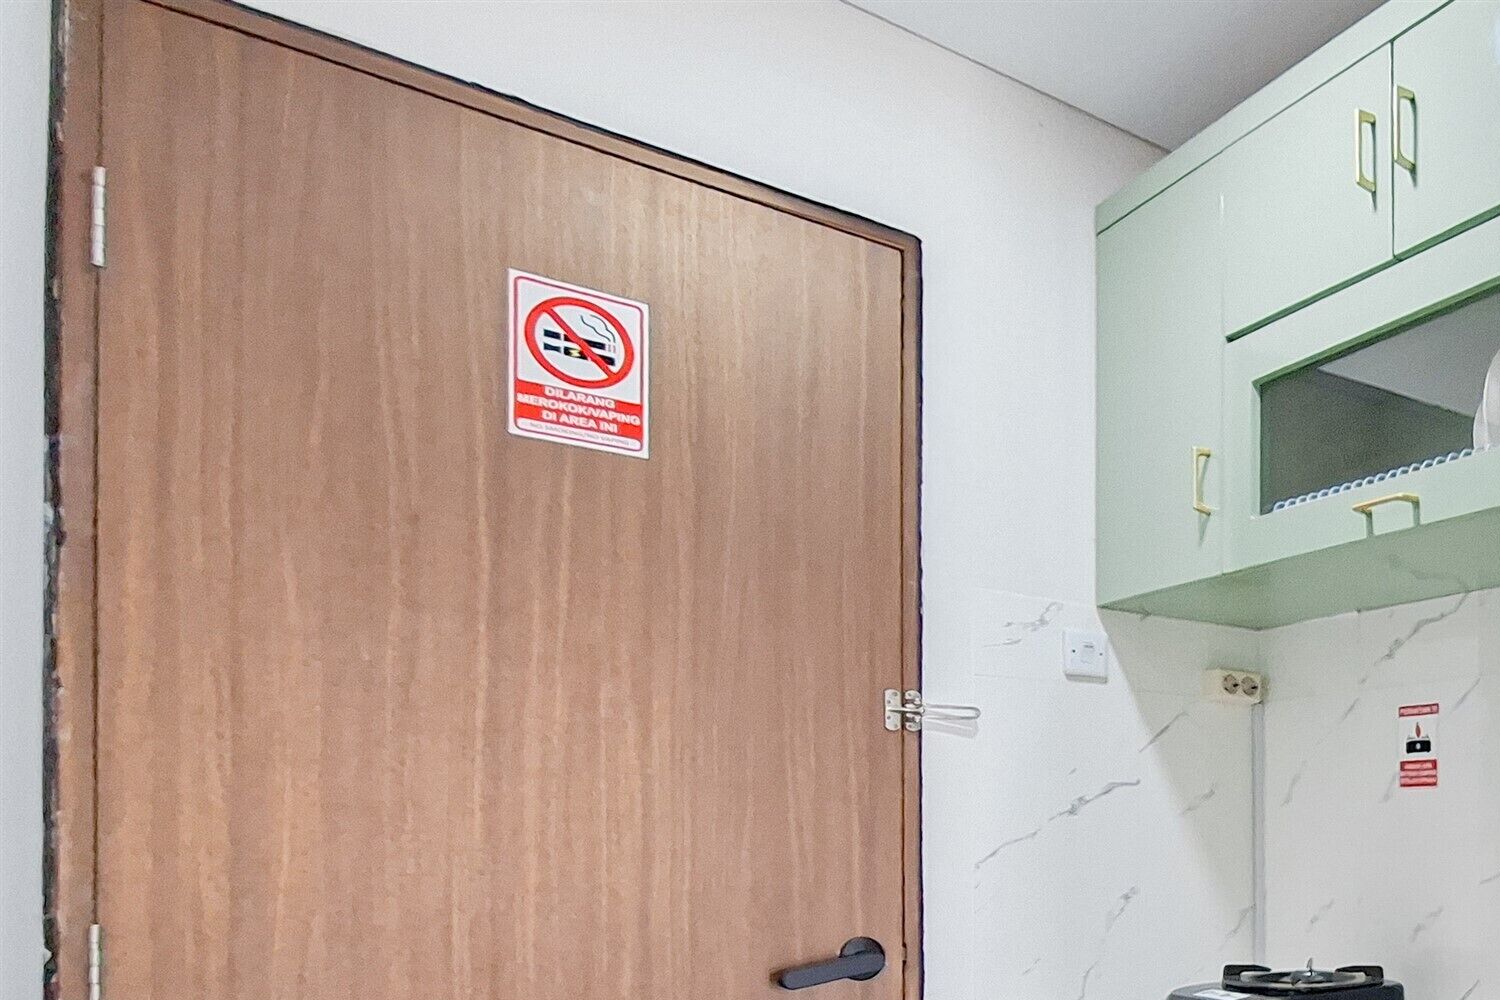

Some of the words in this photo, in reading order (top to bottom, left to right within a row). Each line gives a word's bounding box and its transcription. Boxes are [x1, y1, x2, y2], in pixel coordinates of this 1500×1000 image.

[544, 386, 616, 409] DILARANG
[541, 409, 557, 421] DI
[559, 412, 598, 430] AREA
[599, 419, 618, 433] INI
